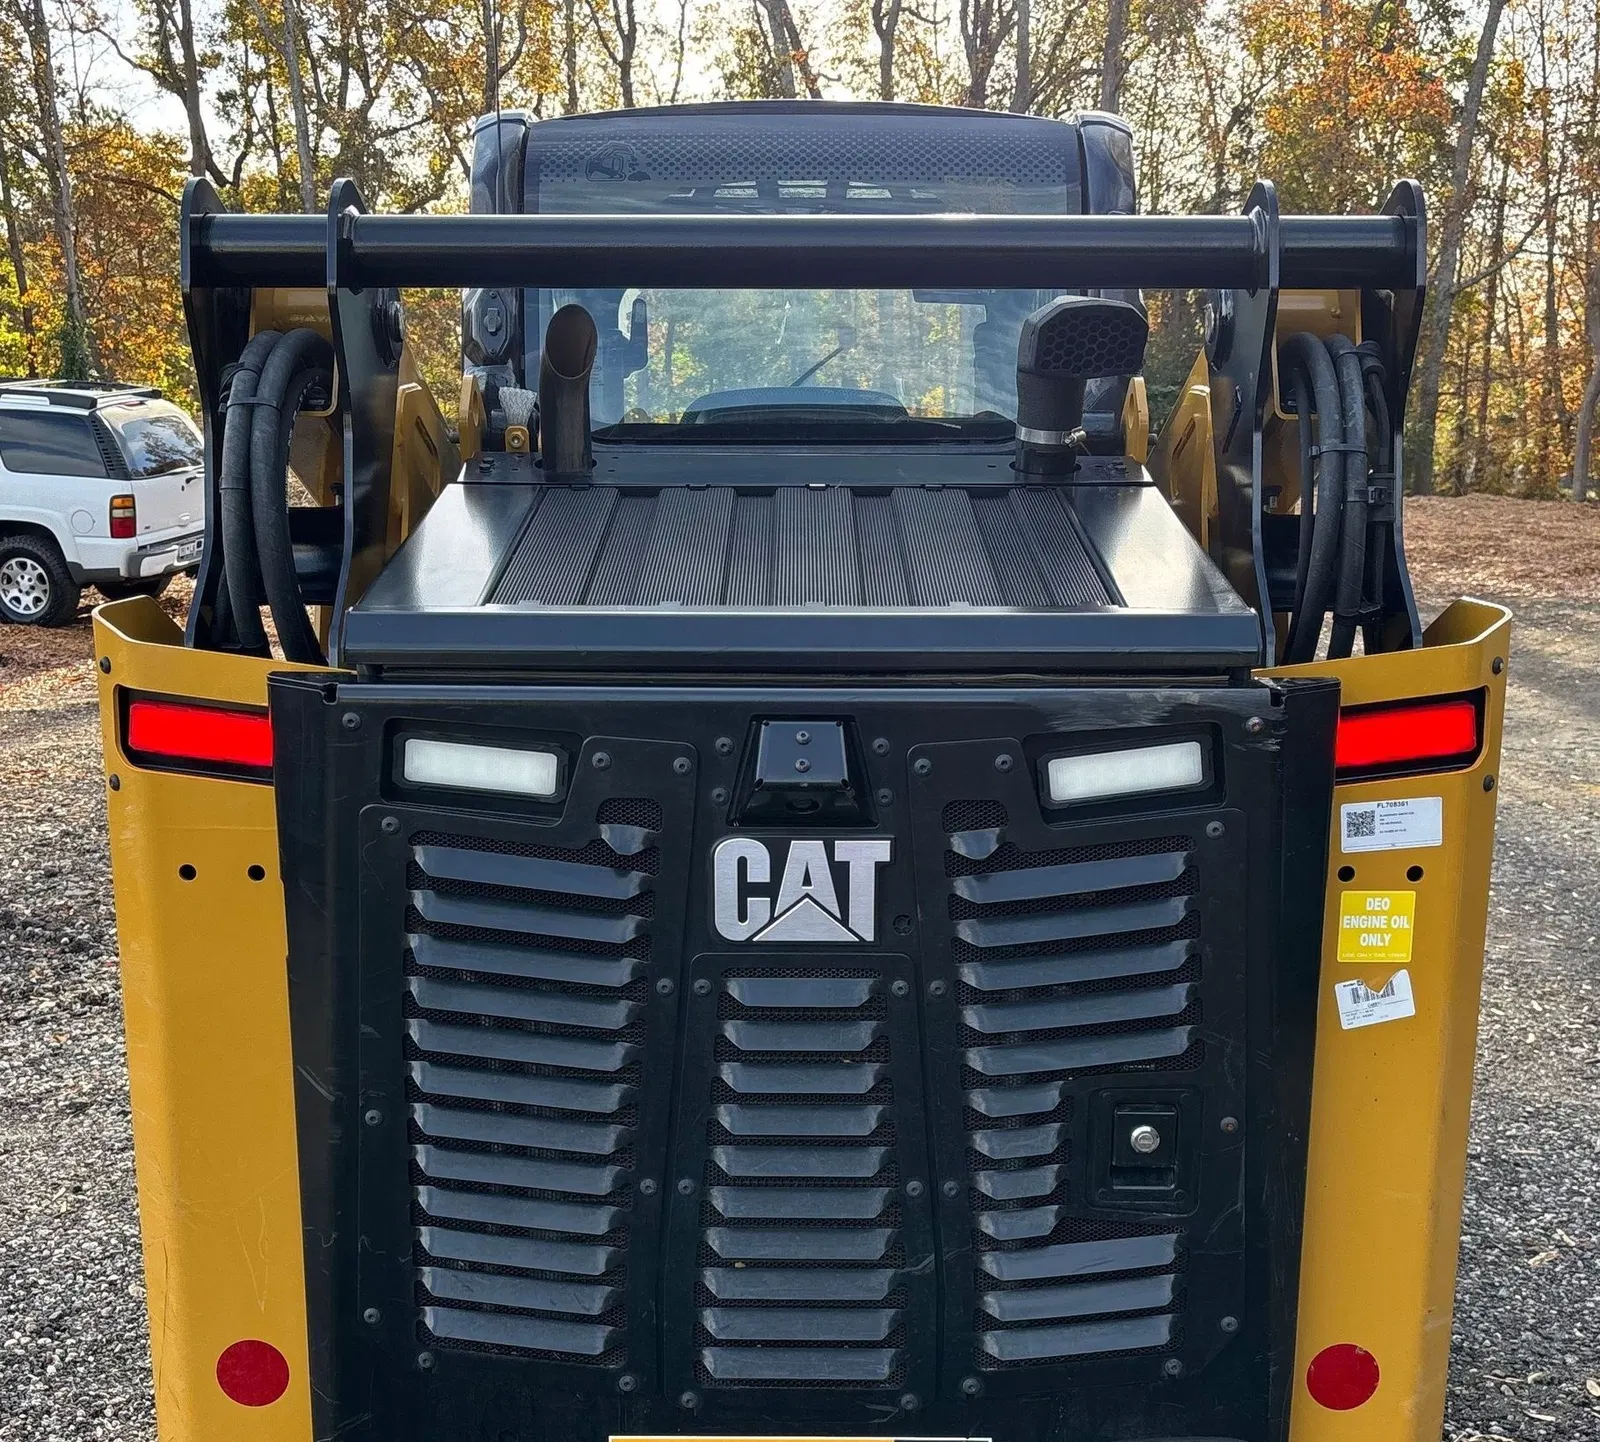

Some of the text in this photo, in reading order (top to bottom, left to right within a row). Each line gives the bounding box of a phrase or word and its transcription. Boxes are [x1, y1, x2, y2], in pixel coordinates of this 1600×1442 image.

[714, 837, 891, 942] CAT
[1366, 897, 1391, 911] DEO
[1343, 915, 1411, 929] ENGINE OIL
[1360, 933, 1391, 947] ONLY
